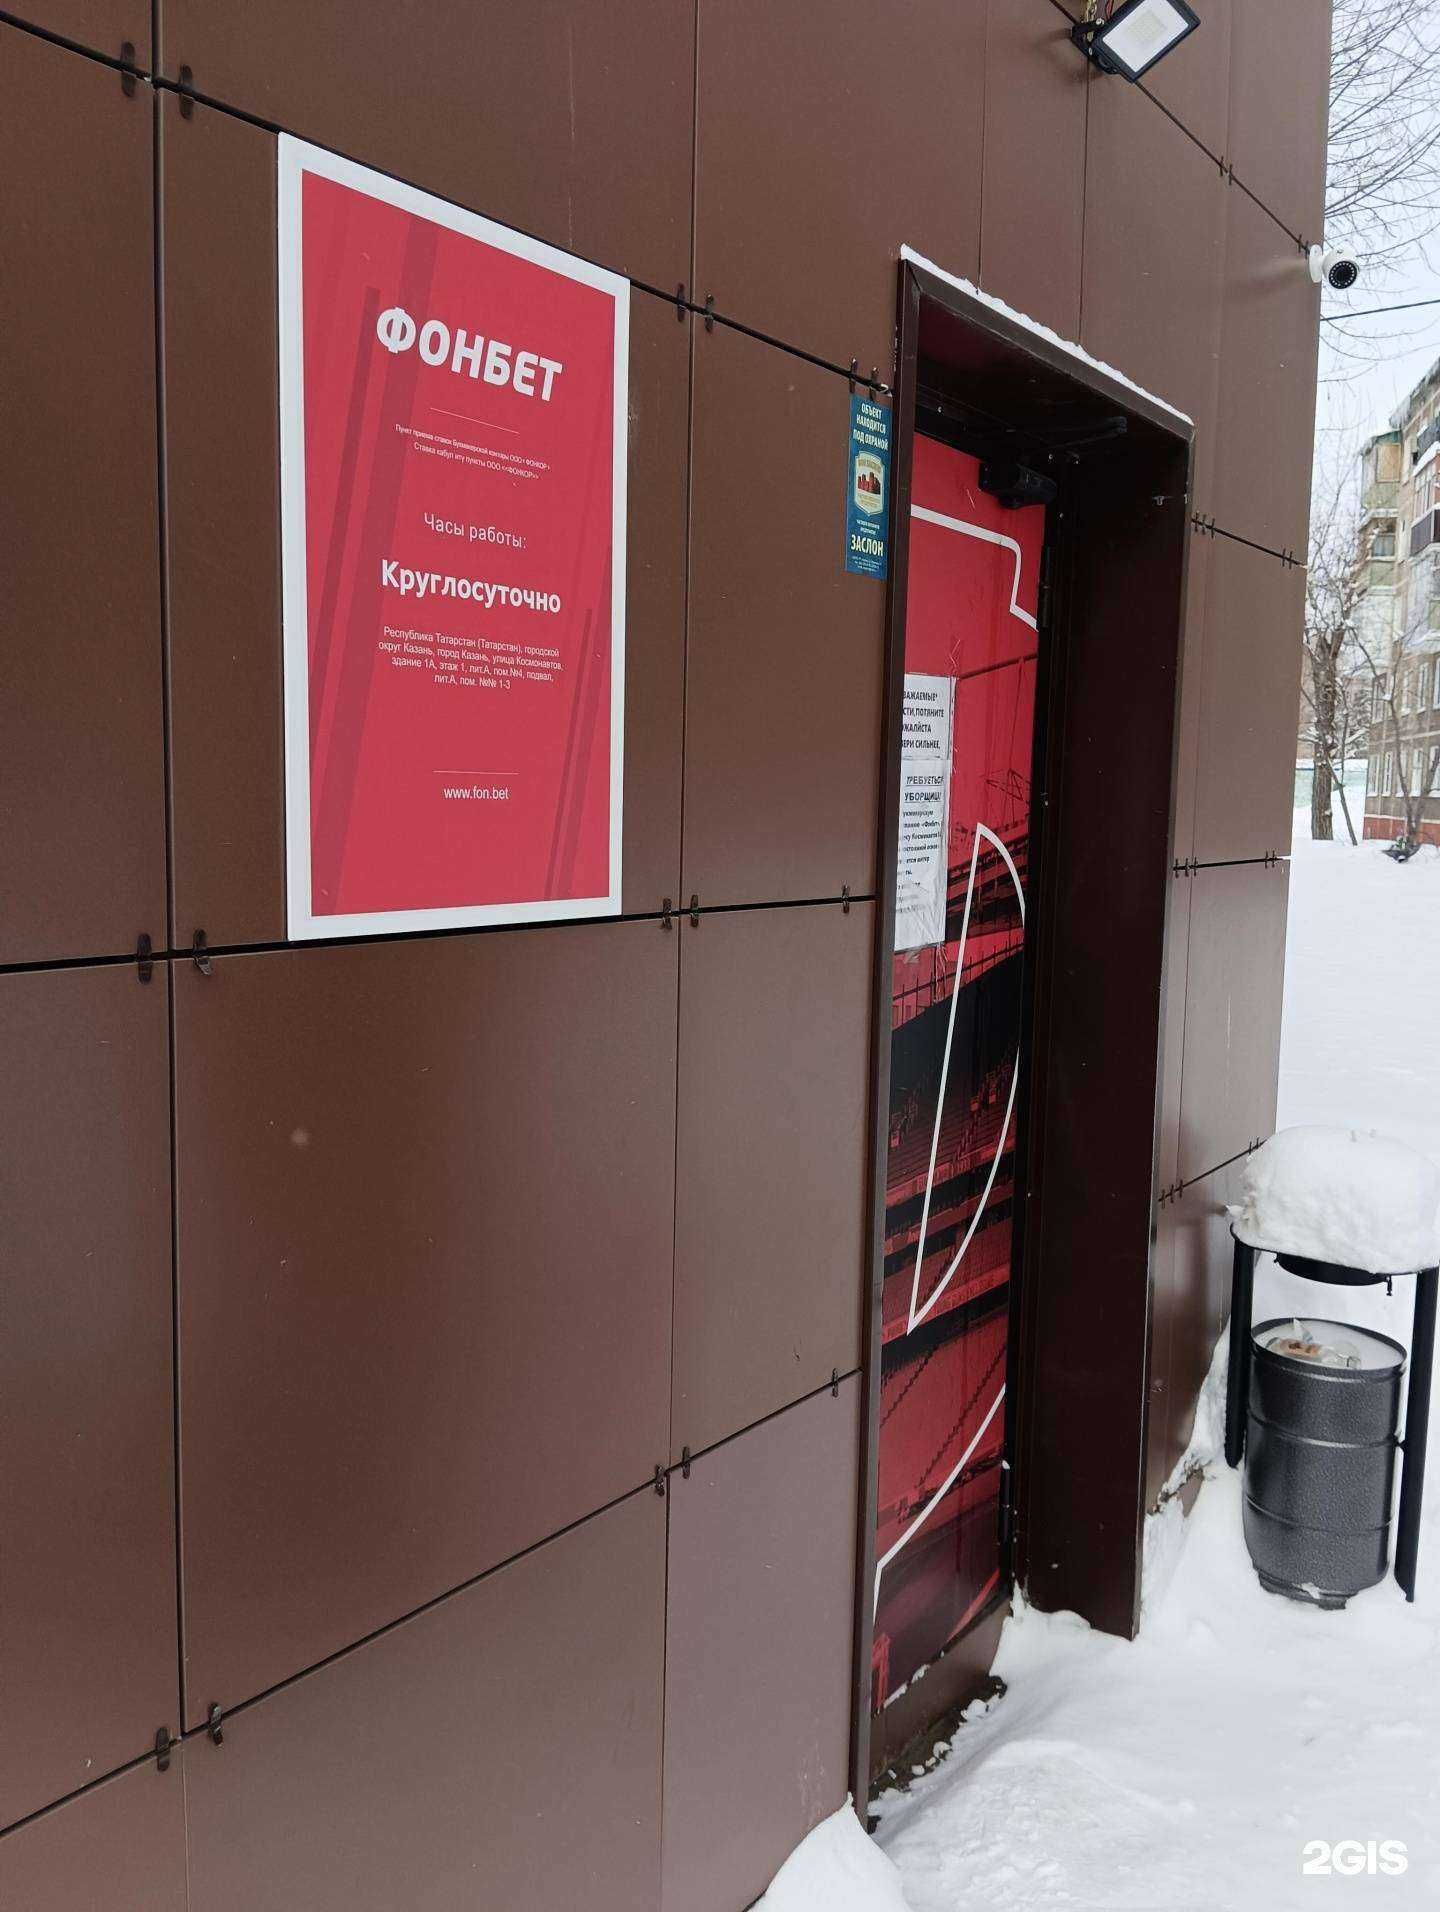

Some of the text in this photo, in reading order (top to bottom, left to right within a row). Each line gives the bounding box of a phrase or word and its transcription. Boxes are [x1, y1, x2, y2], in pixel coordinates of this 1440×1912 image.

[376, 307, 563, 402] ФОНБЕТ
[861, 402, 882, 420] ОБЪЕКТ
[856, 414, 887, 434] НАХОДИТСЯ
[853, 428, 889, 451] ПОД ОХРАНОЙ
[487, 460, 500, 471] ООО
[424, 512, 527, 549] Часы работы:
[851, 534, 884, 557] ЗАСЛОН
[382, 559, 561, 613] Круглосуточно
[383, 626, 560, 657] Республика Татарстан (Татарстан), городской
[378, 642, 401, 653] округ
[403, 643, 435, 657] Казань,
[437, 648, 460, 659] город
[492, 654, 515, 665] улица
[391, 657, 422, 668] здание
[439, 662, 459, 671] этаж
[499, 679, 511, 689] 1-3
[443, 785, 509, 800] www.fon.bet
